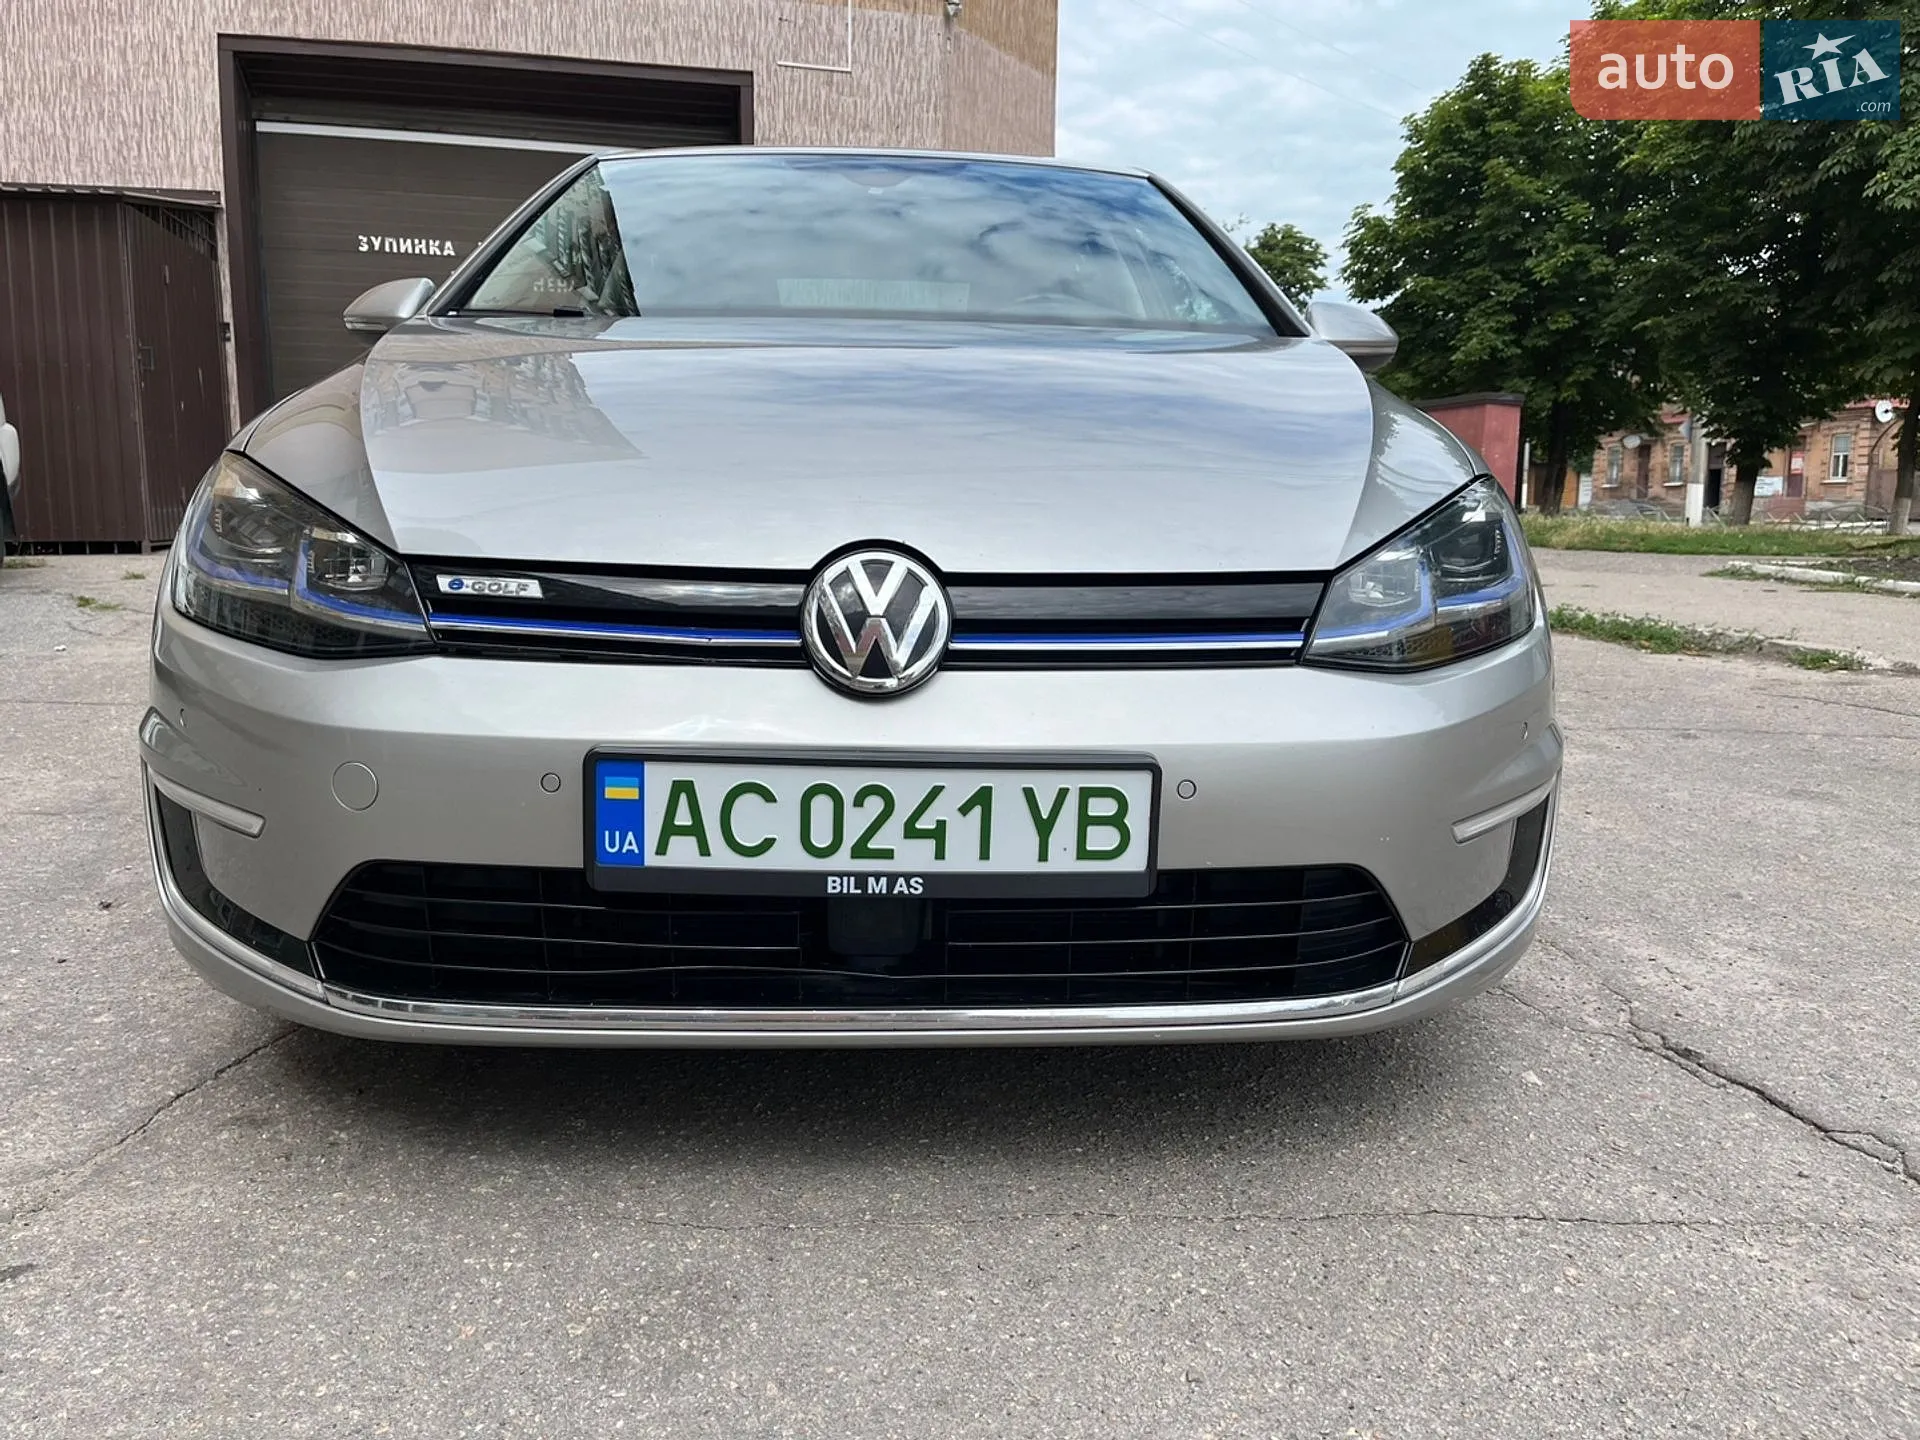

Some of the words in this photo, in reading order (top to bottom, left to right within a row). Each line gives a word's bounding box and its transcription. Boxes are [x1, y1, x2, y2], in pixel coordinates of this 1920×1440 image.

[358, 235, 456, 256] ЗУПИНКА
[604, 831, 639, 854] UA
[655, 779, 778, 858] AC
[800, 782, 994, 861] 0241
[1021, 786, 1131, 862] YB
[827, 876, 862, 894] BIL
[867, 876, 887, 894] M
[893, 876, 924, 895] AS
